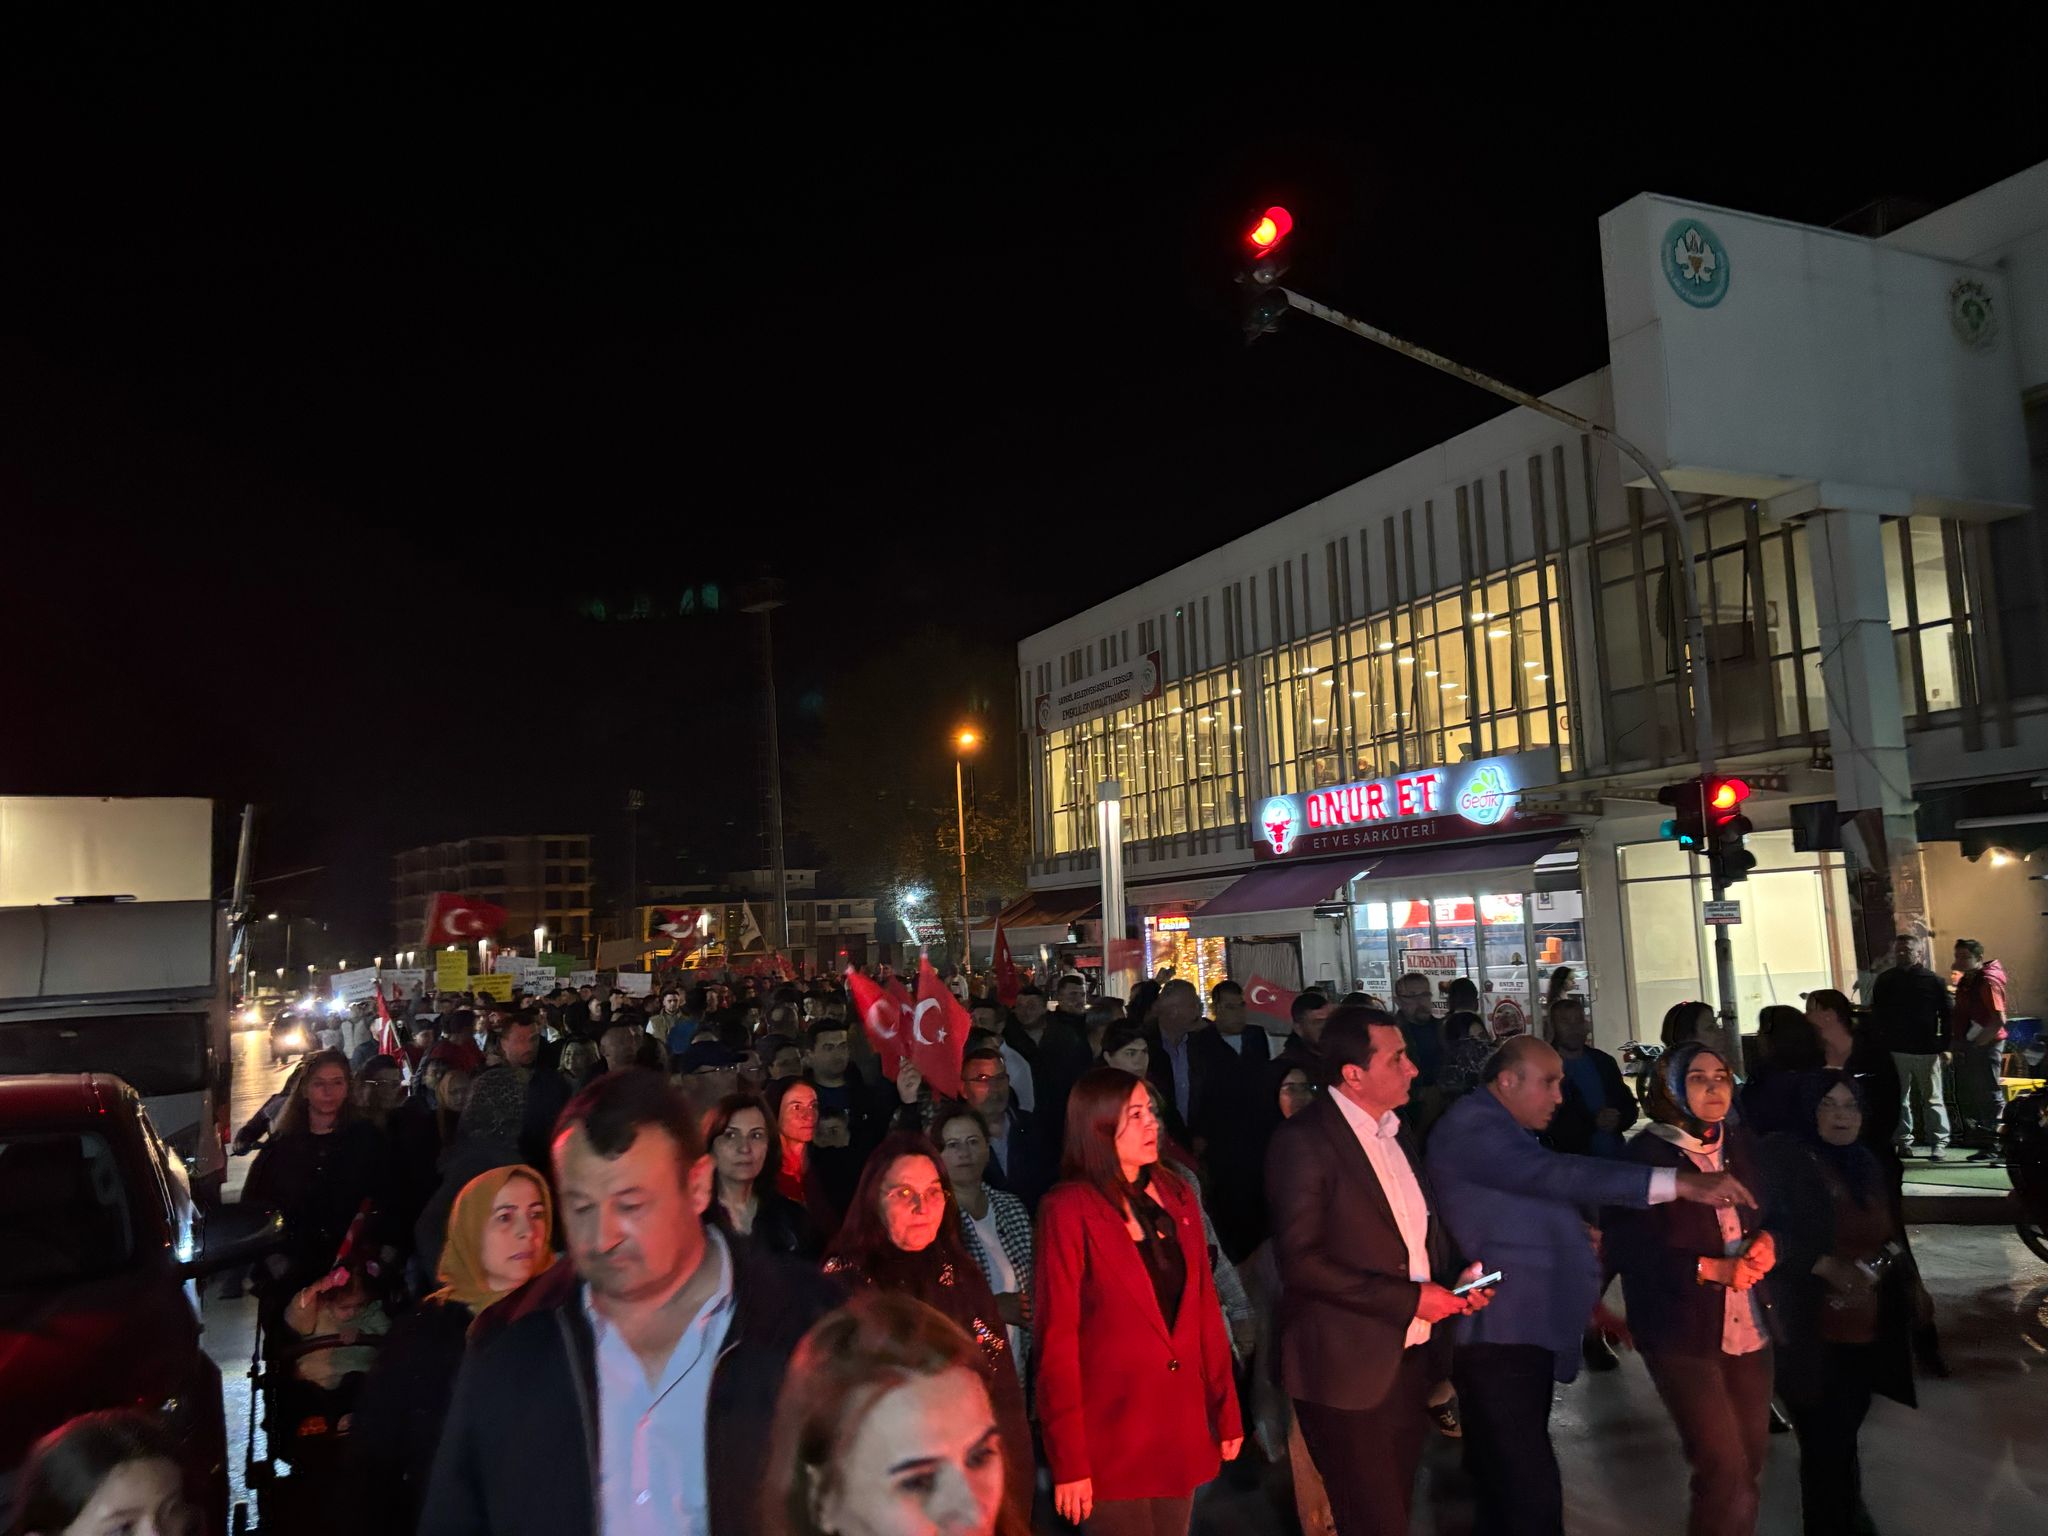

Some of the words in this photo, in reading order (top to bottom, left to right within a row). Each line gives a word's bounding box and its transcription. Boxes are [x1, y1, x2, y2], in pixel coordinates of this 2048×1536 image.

[1307, 783, 1387, 828] ONUR
[1396, 774, 1437, 816] ET
[1313, 837, 1328, 849] ET
[1332, 834, 1349, 847] VE
[1353, 820, 1437, 846] ŞARKÜTERİ
